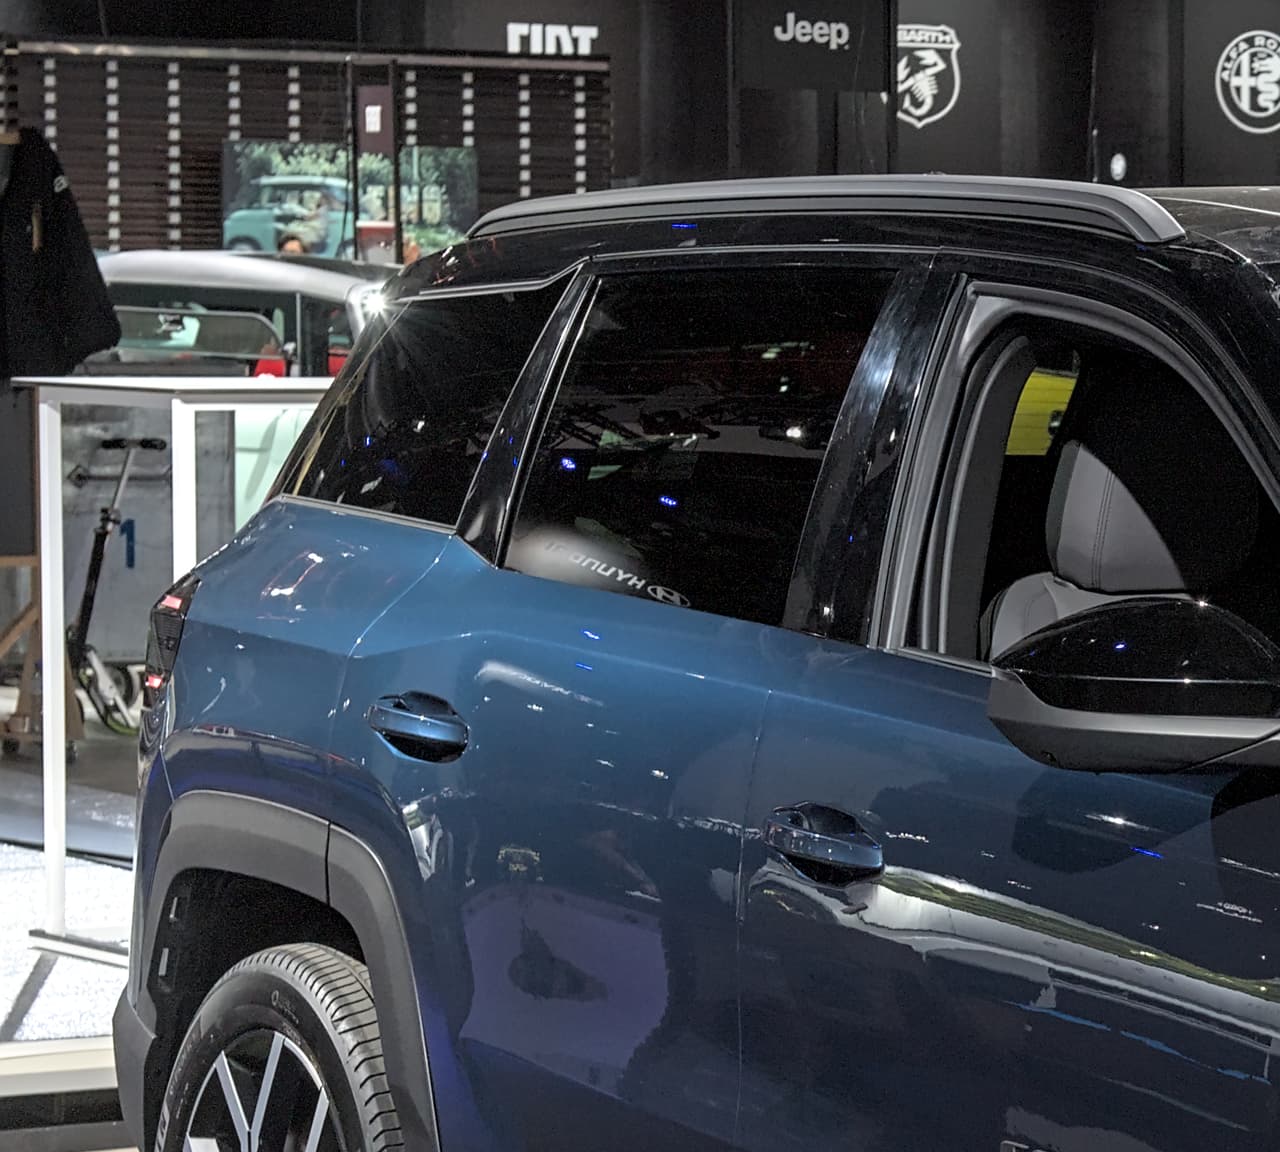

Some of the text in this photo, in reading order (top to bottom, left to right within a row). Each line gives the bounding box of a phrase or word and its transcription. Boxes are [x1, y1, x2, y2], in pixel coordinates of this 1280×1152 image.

[774, 12, 849, 49] Jeep
[898, 30, 952, 43] BARTH
[1221, 41, 1250, 82] ALFA
